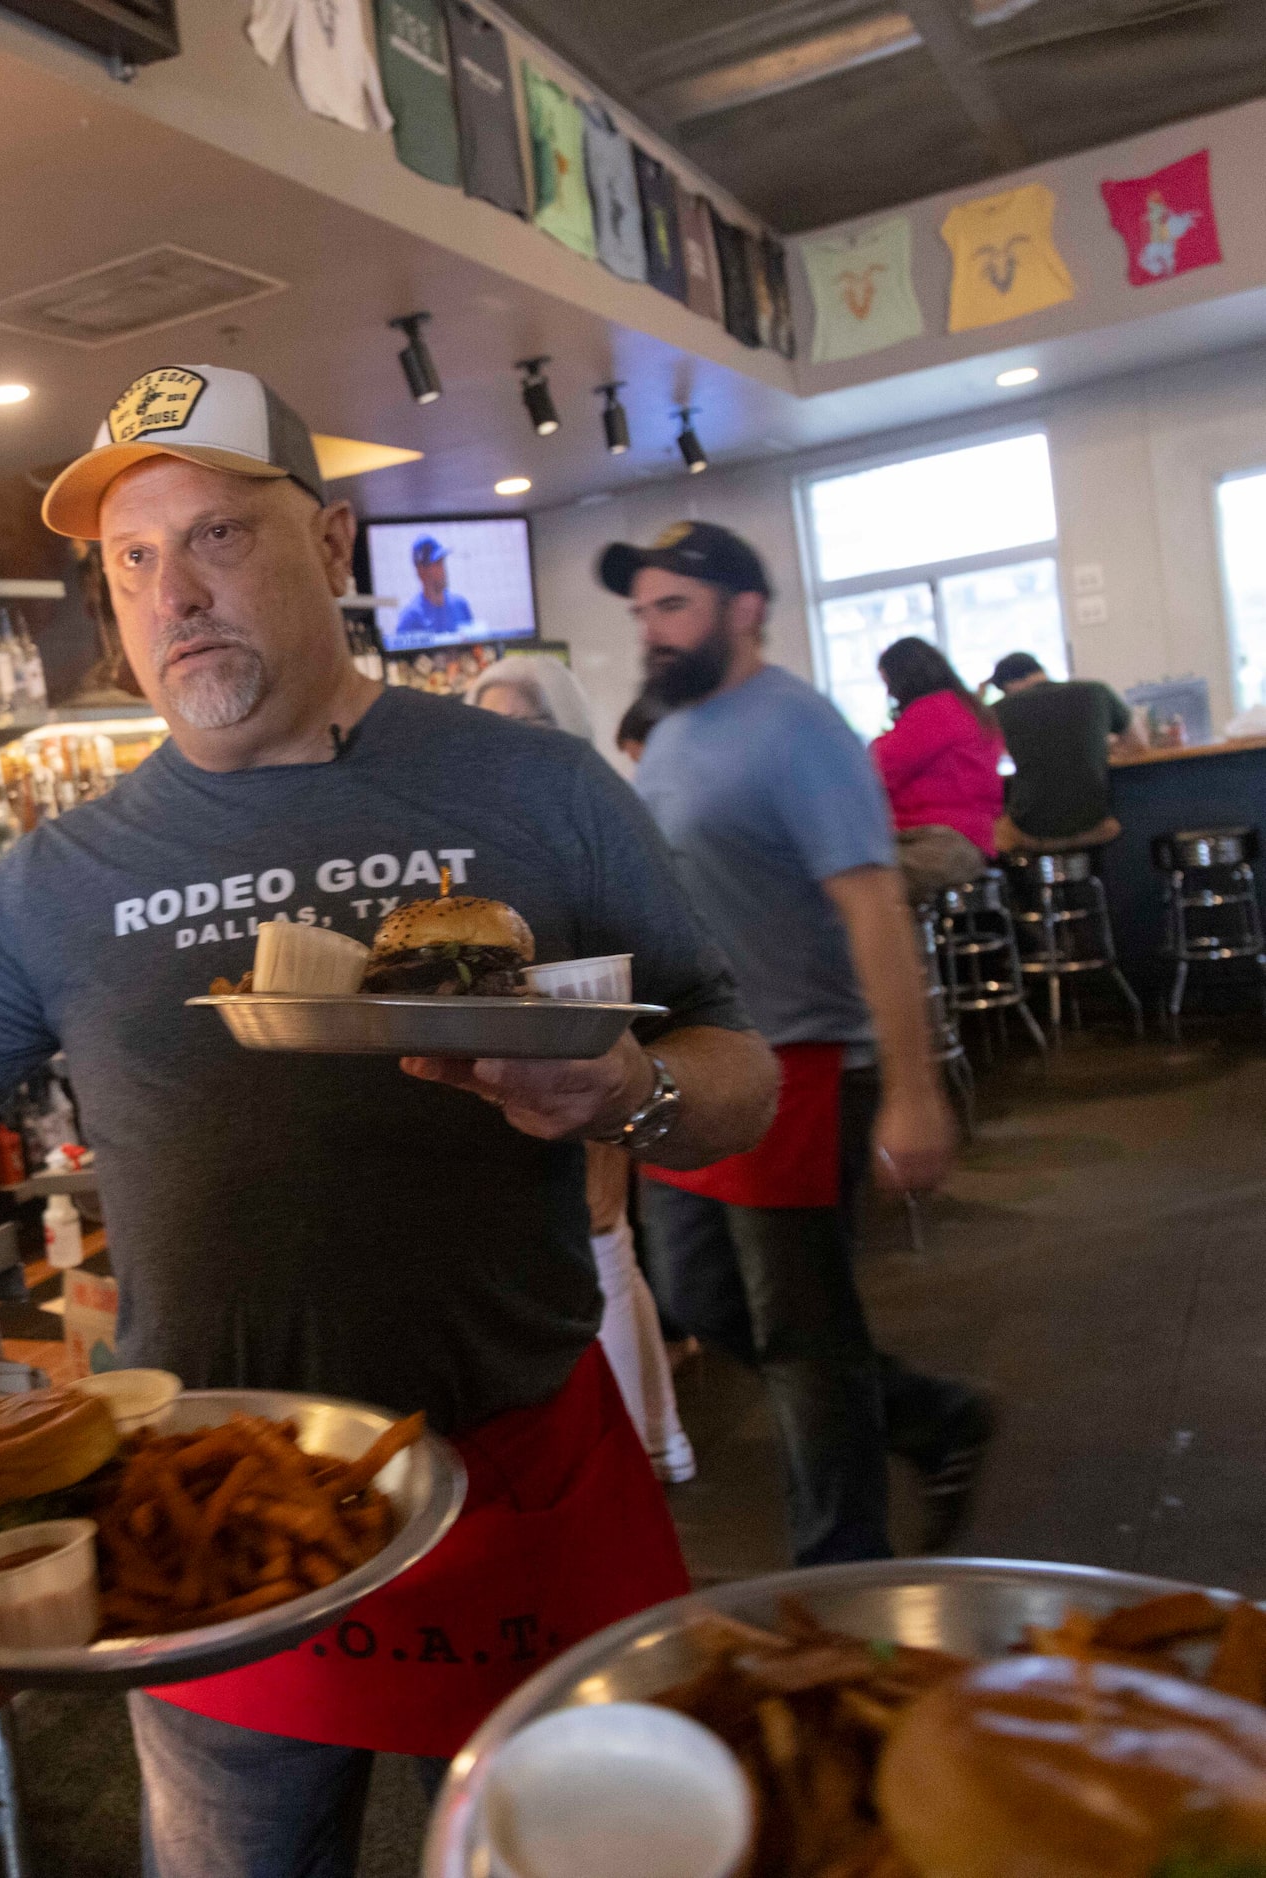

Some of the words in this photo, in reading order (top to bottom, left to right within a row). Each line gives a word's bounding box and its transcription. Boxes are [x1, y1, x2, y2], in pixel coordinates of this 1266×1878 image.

[139, 410, 179, 425] HOUSE
[113, 867, 296, 937] RODEO
[315, 848, 476, 893] GOAT
